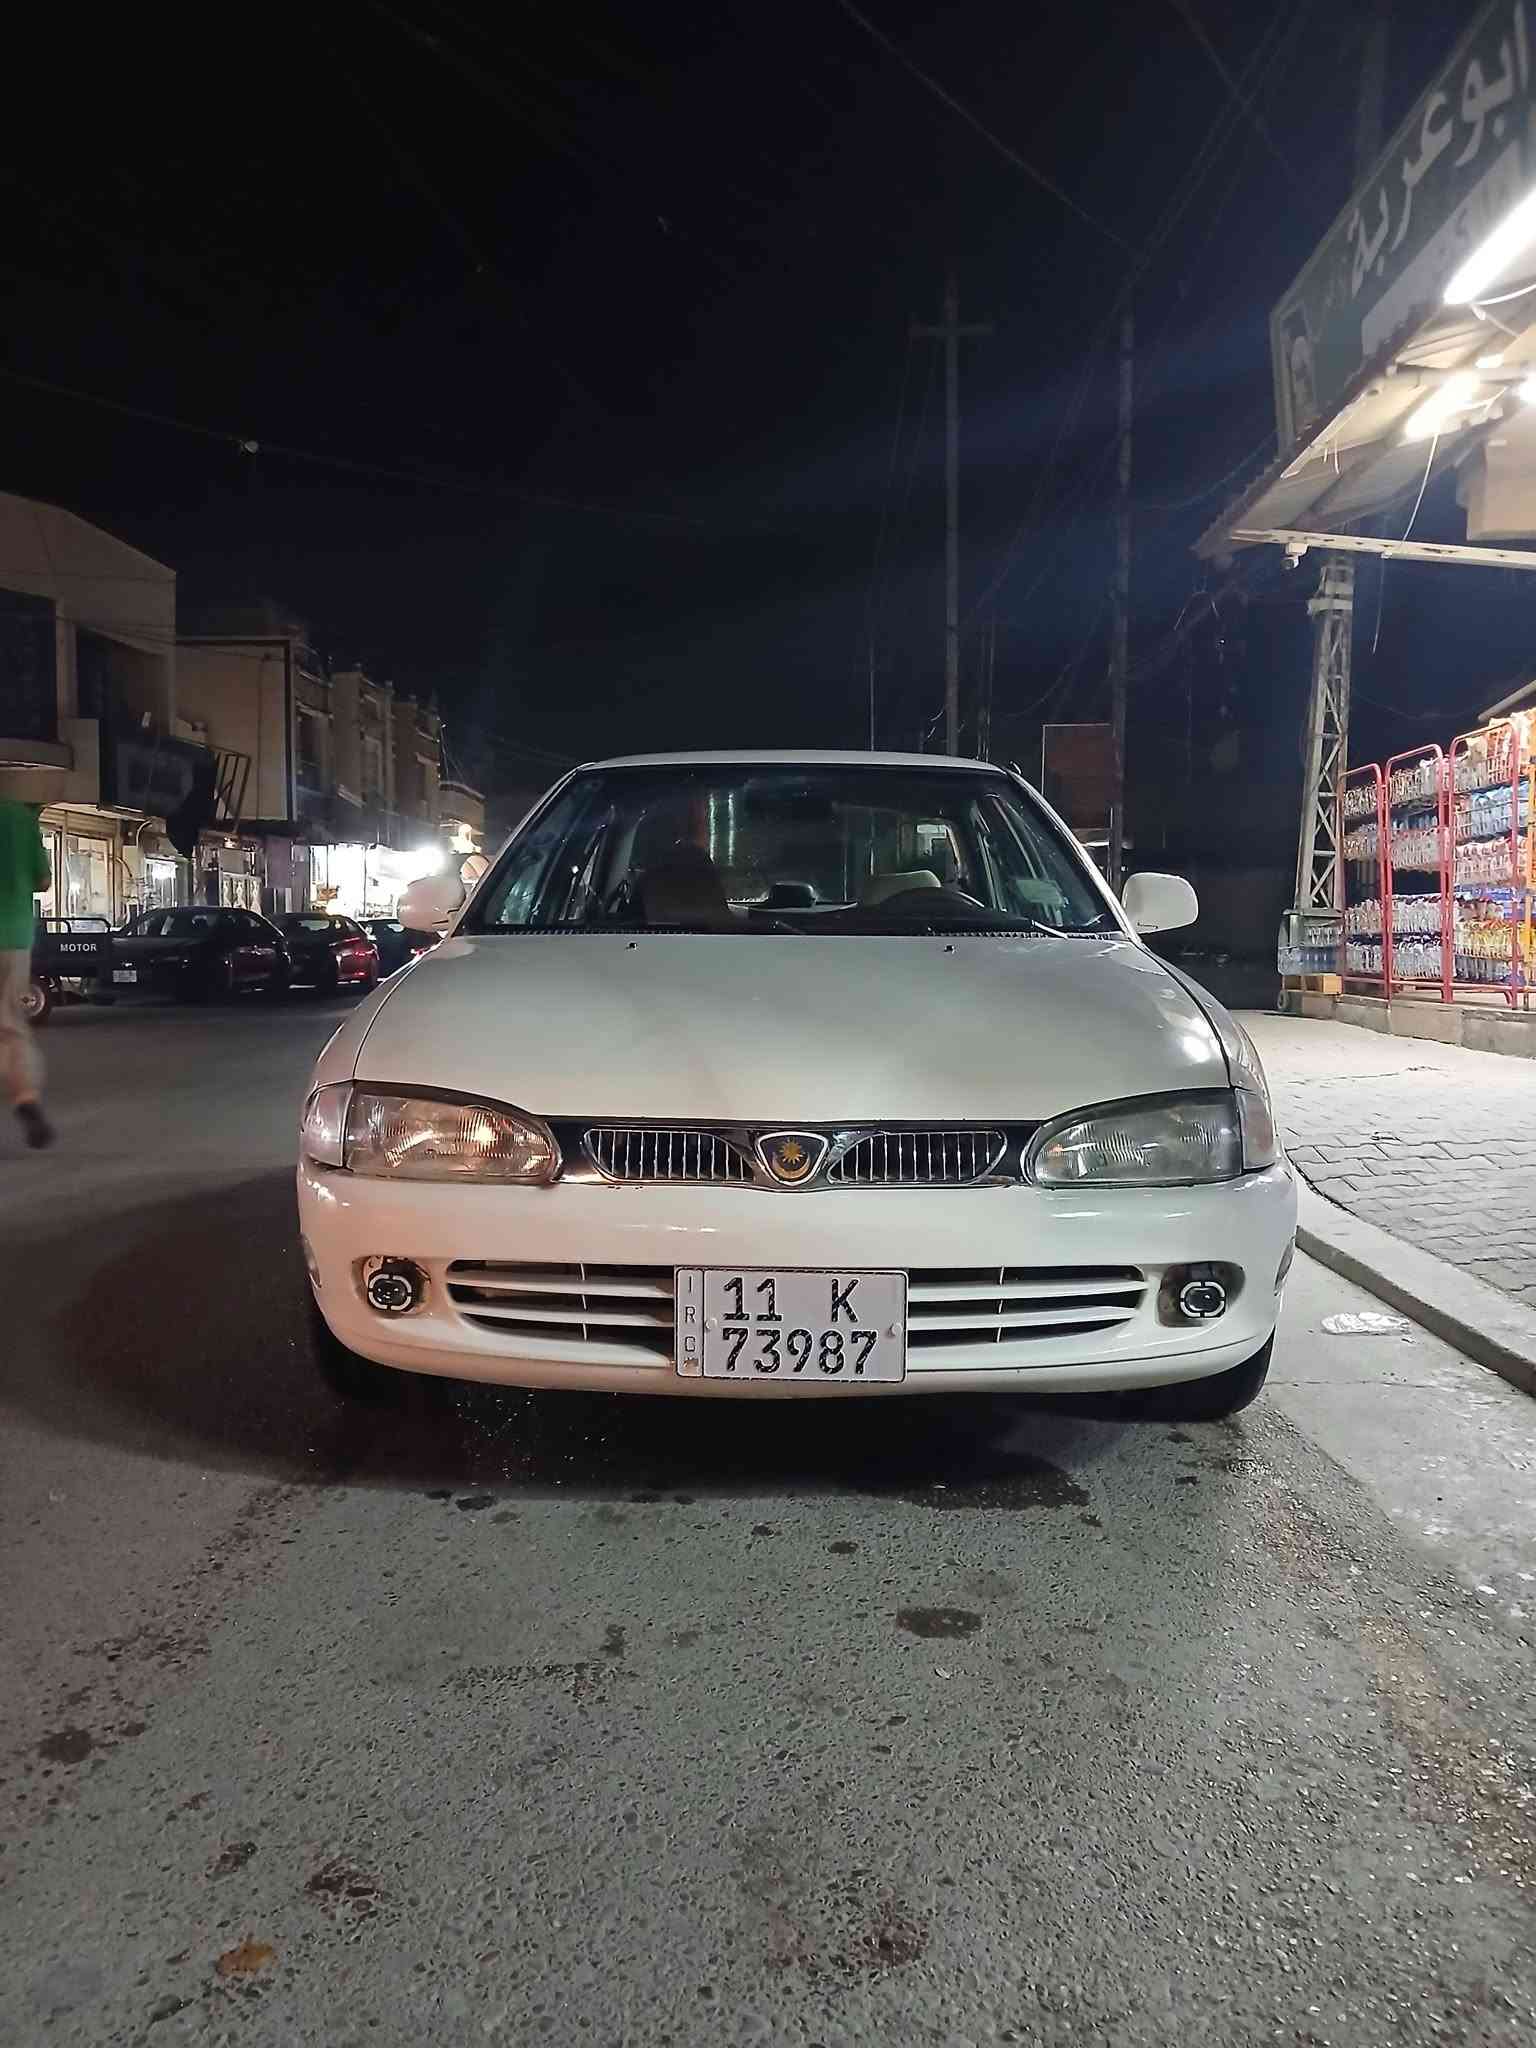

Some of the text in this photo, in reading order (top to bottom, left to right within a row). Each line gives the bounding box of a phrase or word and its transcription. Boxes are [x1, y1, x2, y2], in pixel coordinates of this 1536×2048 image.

[60, 943, 97, 952] MOTOR
[723, 1277, 859, 1323] 11 K
[722, 1327, 878, 1374] 73987
